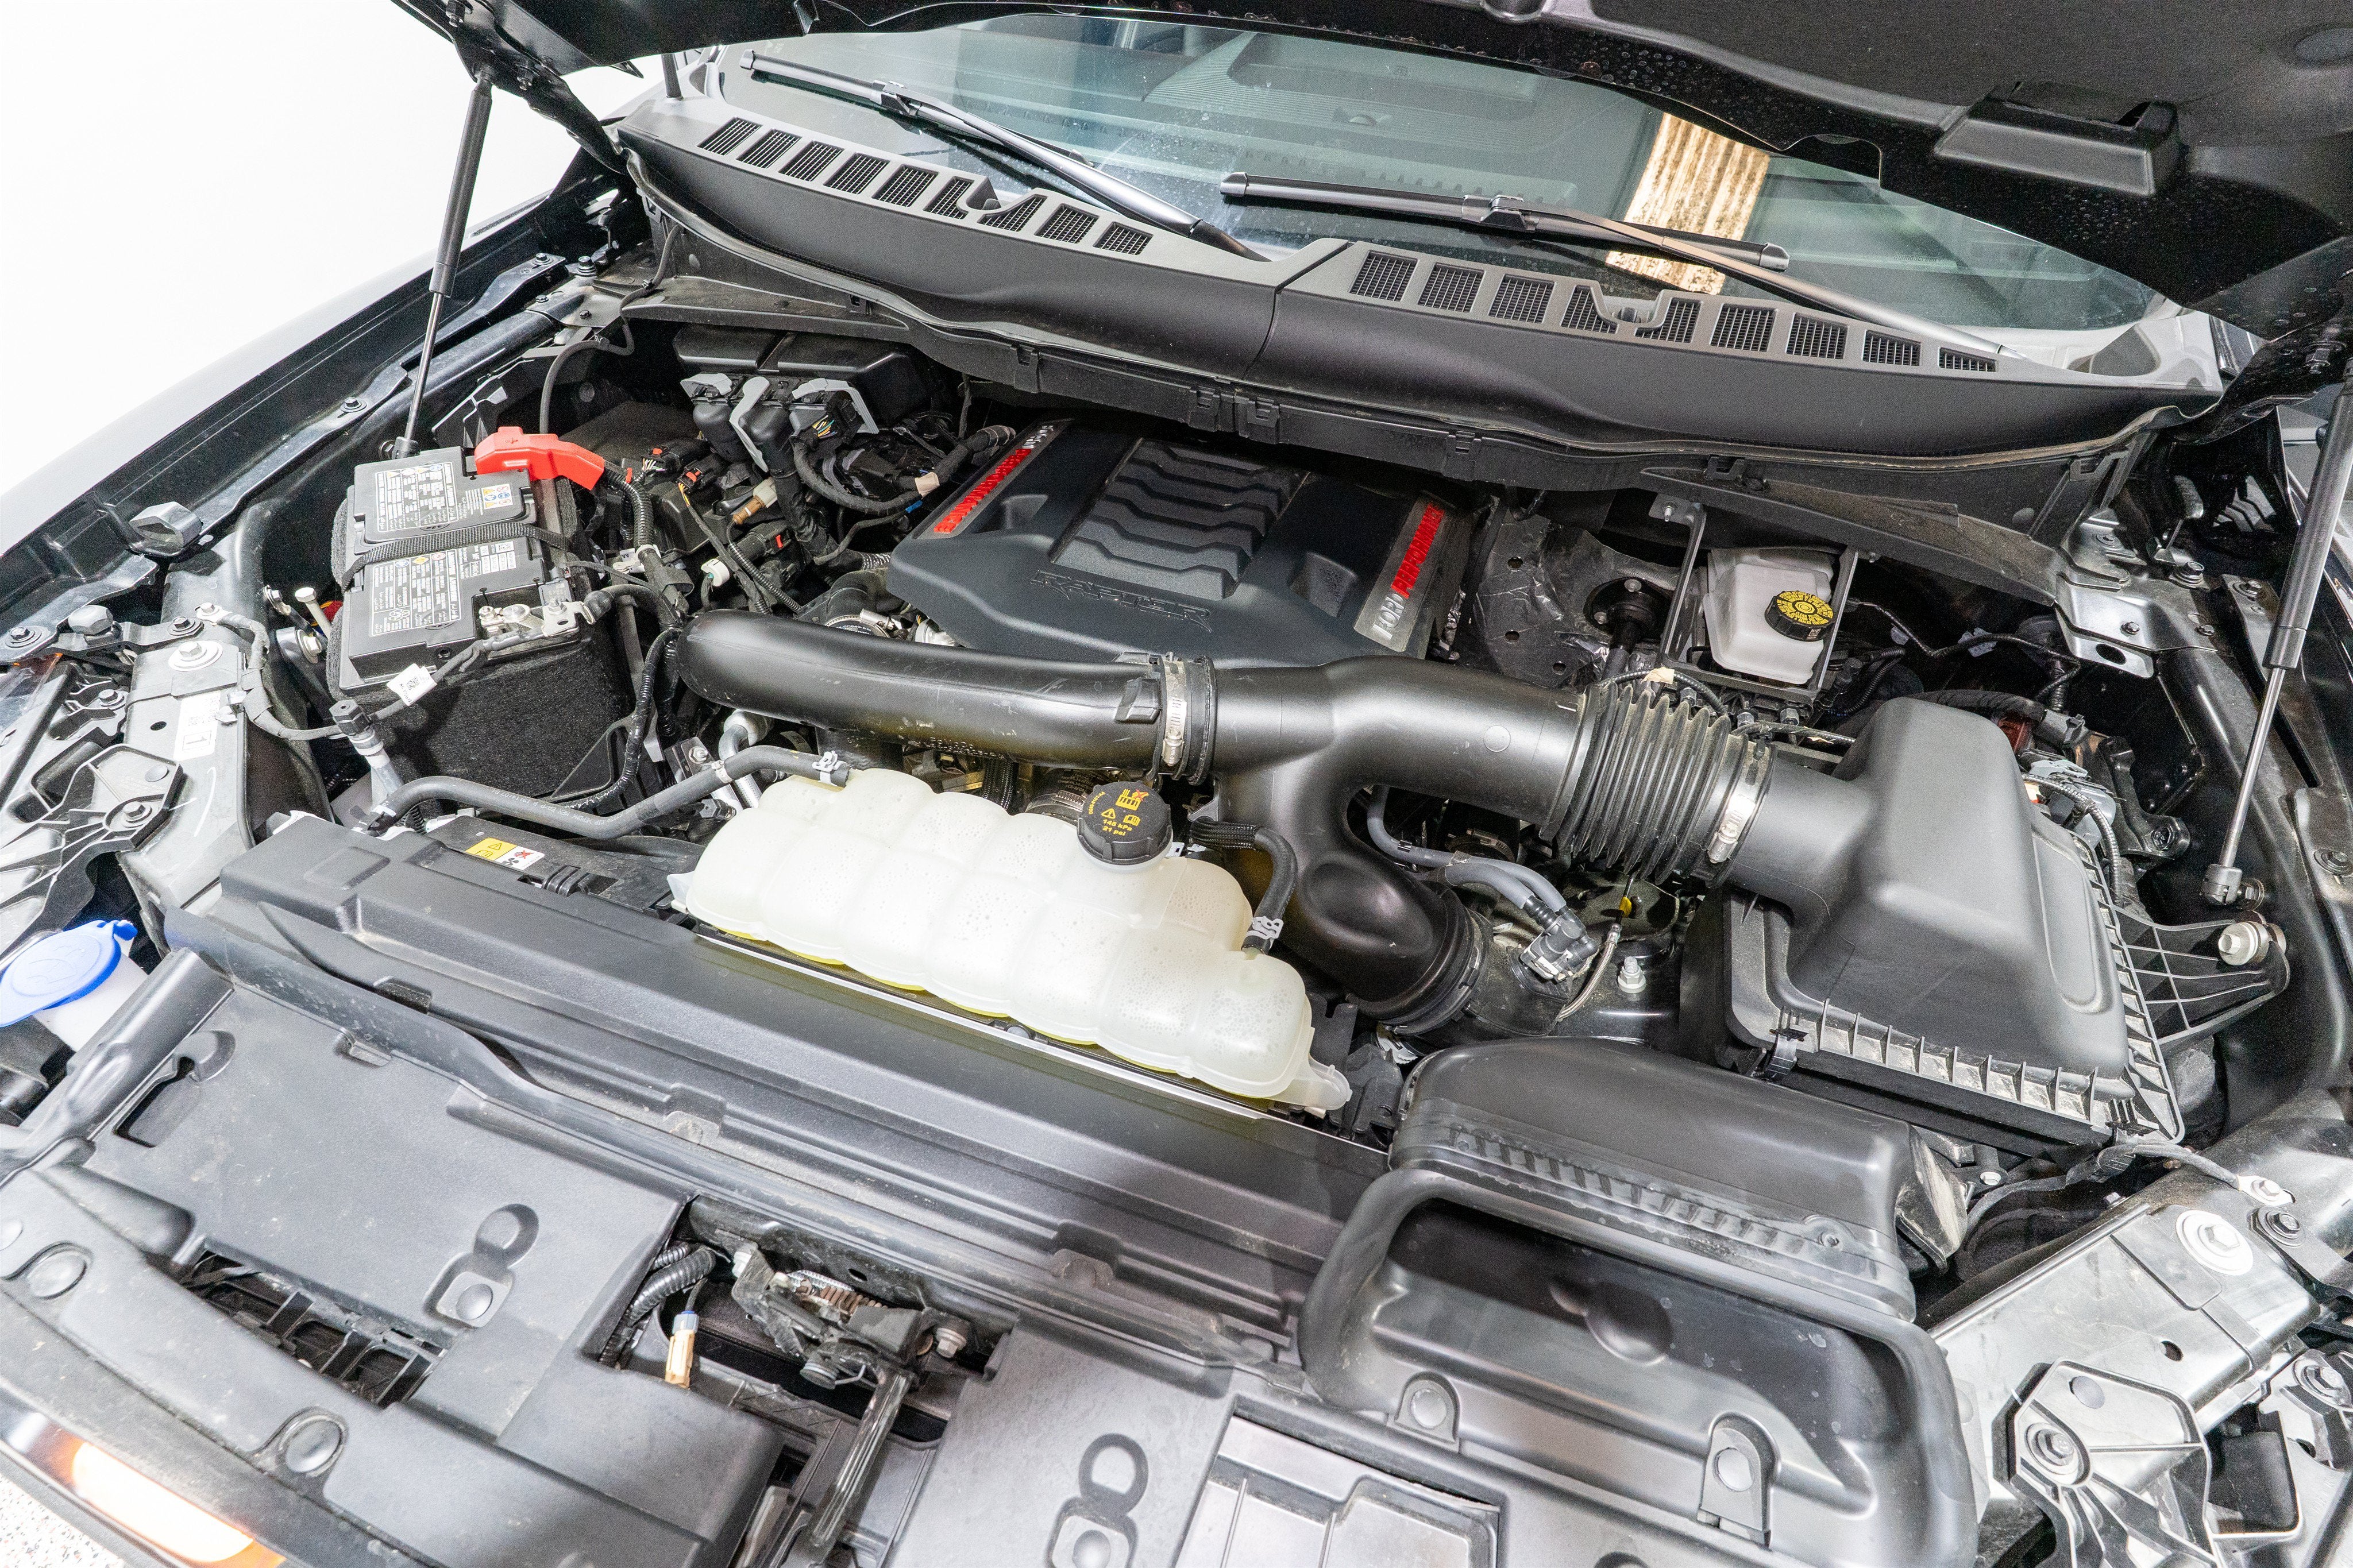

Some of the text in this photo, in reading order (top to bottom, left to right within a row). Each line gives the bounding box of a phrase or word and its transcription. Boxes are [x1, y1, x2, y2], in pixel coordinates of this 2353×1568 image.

[1030, 570, 1213, 634] RAPTOR
[1372, 593, 1405, 640] FORD
[1118, 823, 1132, 831] kPa
